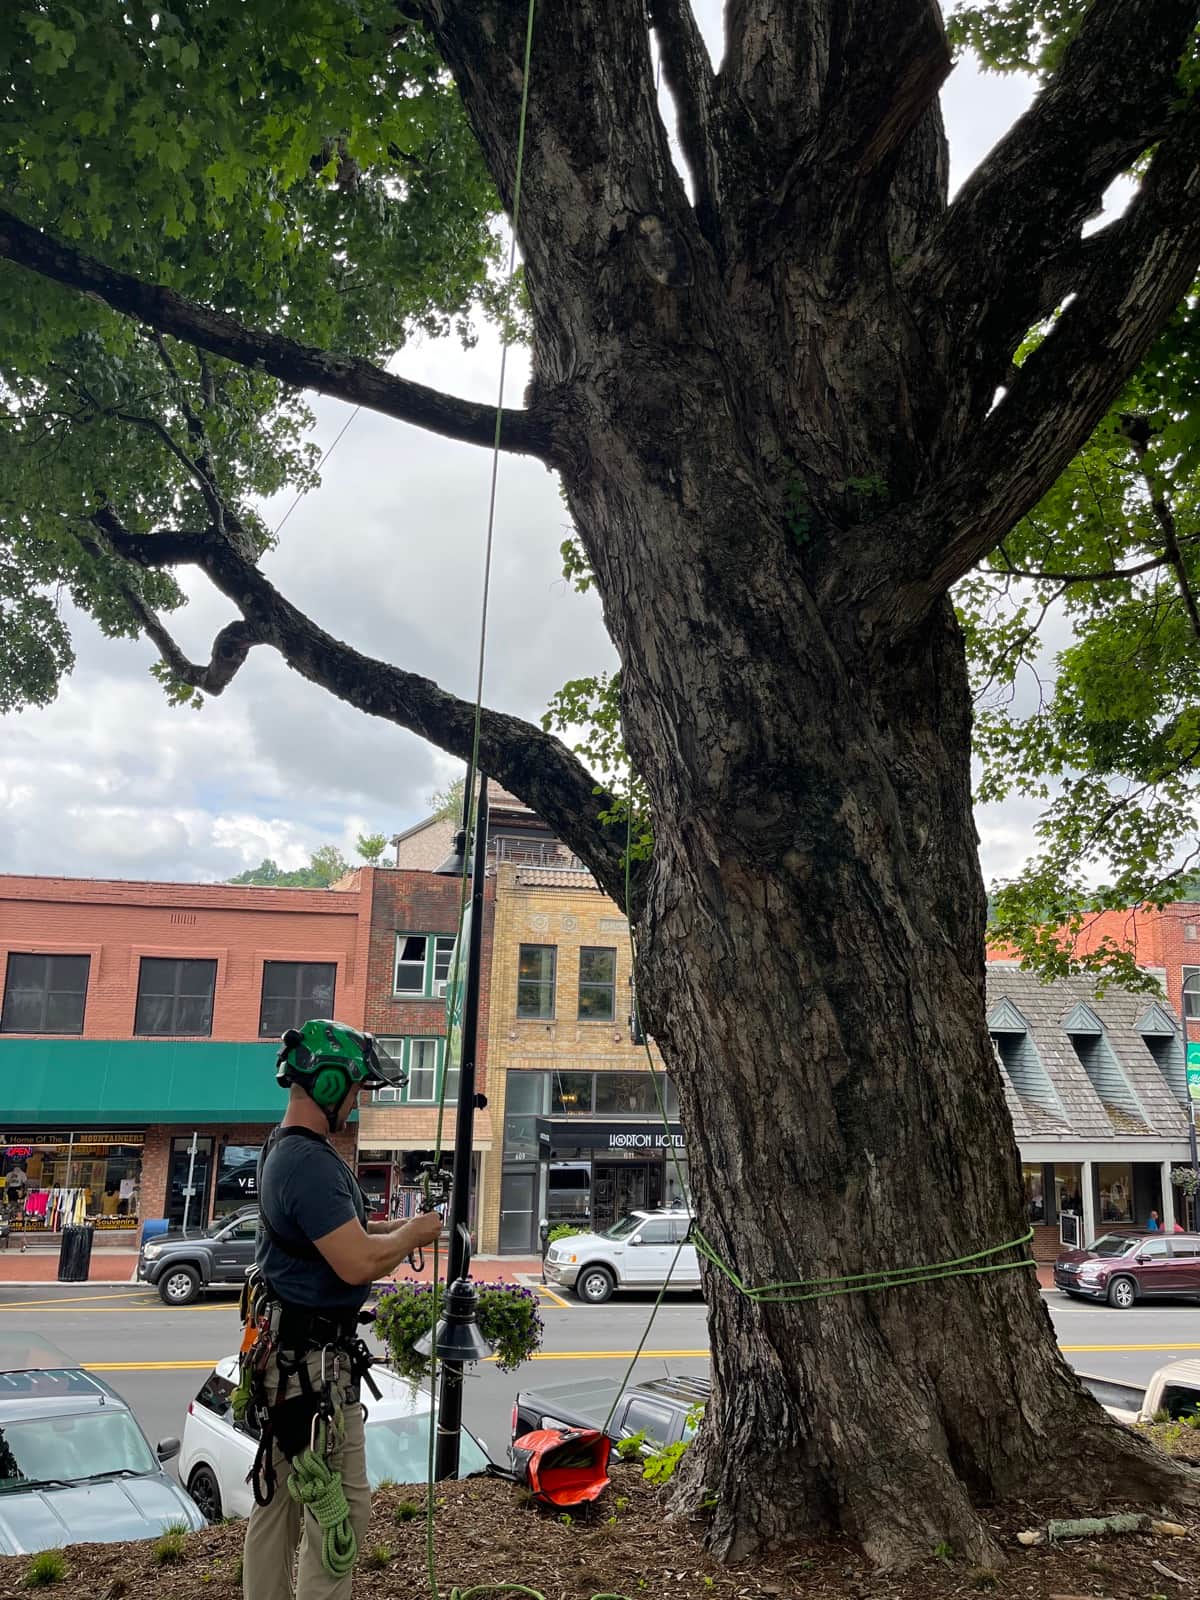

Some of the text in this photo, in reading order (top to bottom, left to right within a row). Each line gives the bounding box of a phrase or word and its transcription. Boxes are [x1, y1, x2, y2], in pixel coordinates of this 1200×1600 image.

[10, 1136, 34, 1144] Home
[609, 1134, 686, 1147] HORTON HOTEL
[7, 1147, 31, 1156] OPEN
[97, 1218, 135, 1226] Souvenirs
